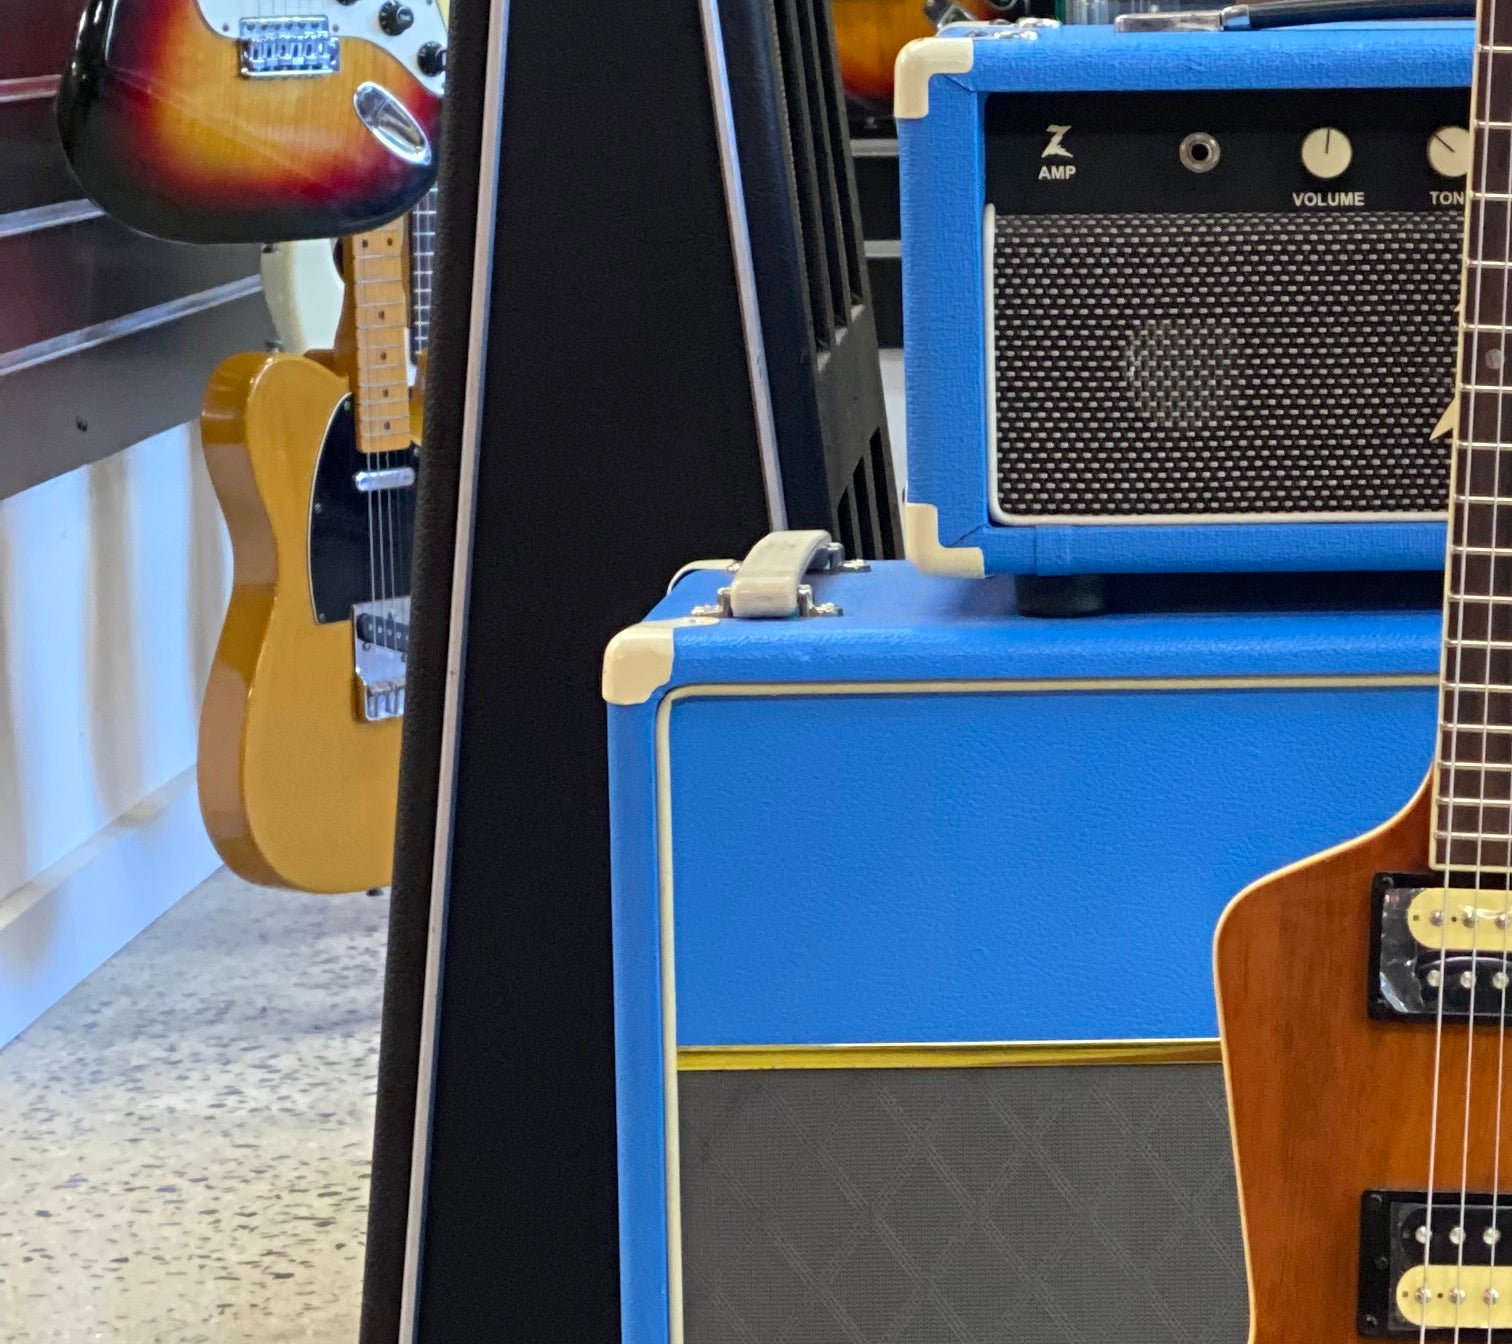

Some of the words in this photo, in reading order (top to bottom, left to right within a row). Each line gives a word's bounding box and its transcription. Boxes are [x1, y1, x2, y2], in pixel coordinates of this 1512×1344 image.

[1041, 124, 1074, 158] Z
[1038, 165, 1077, 180] AMP
[1292, 191, 1365, 207] VOLUME
[1429, 191, 1465, 206] TON
